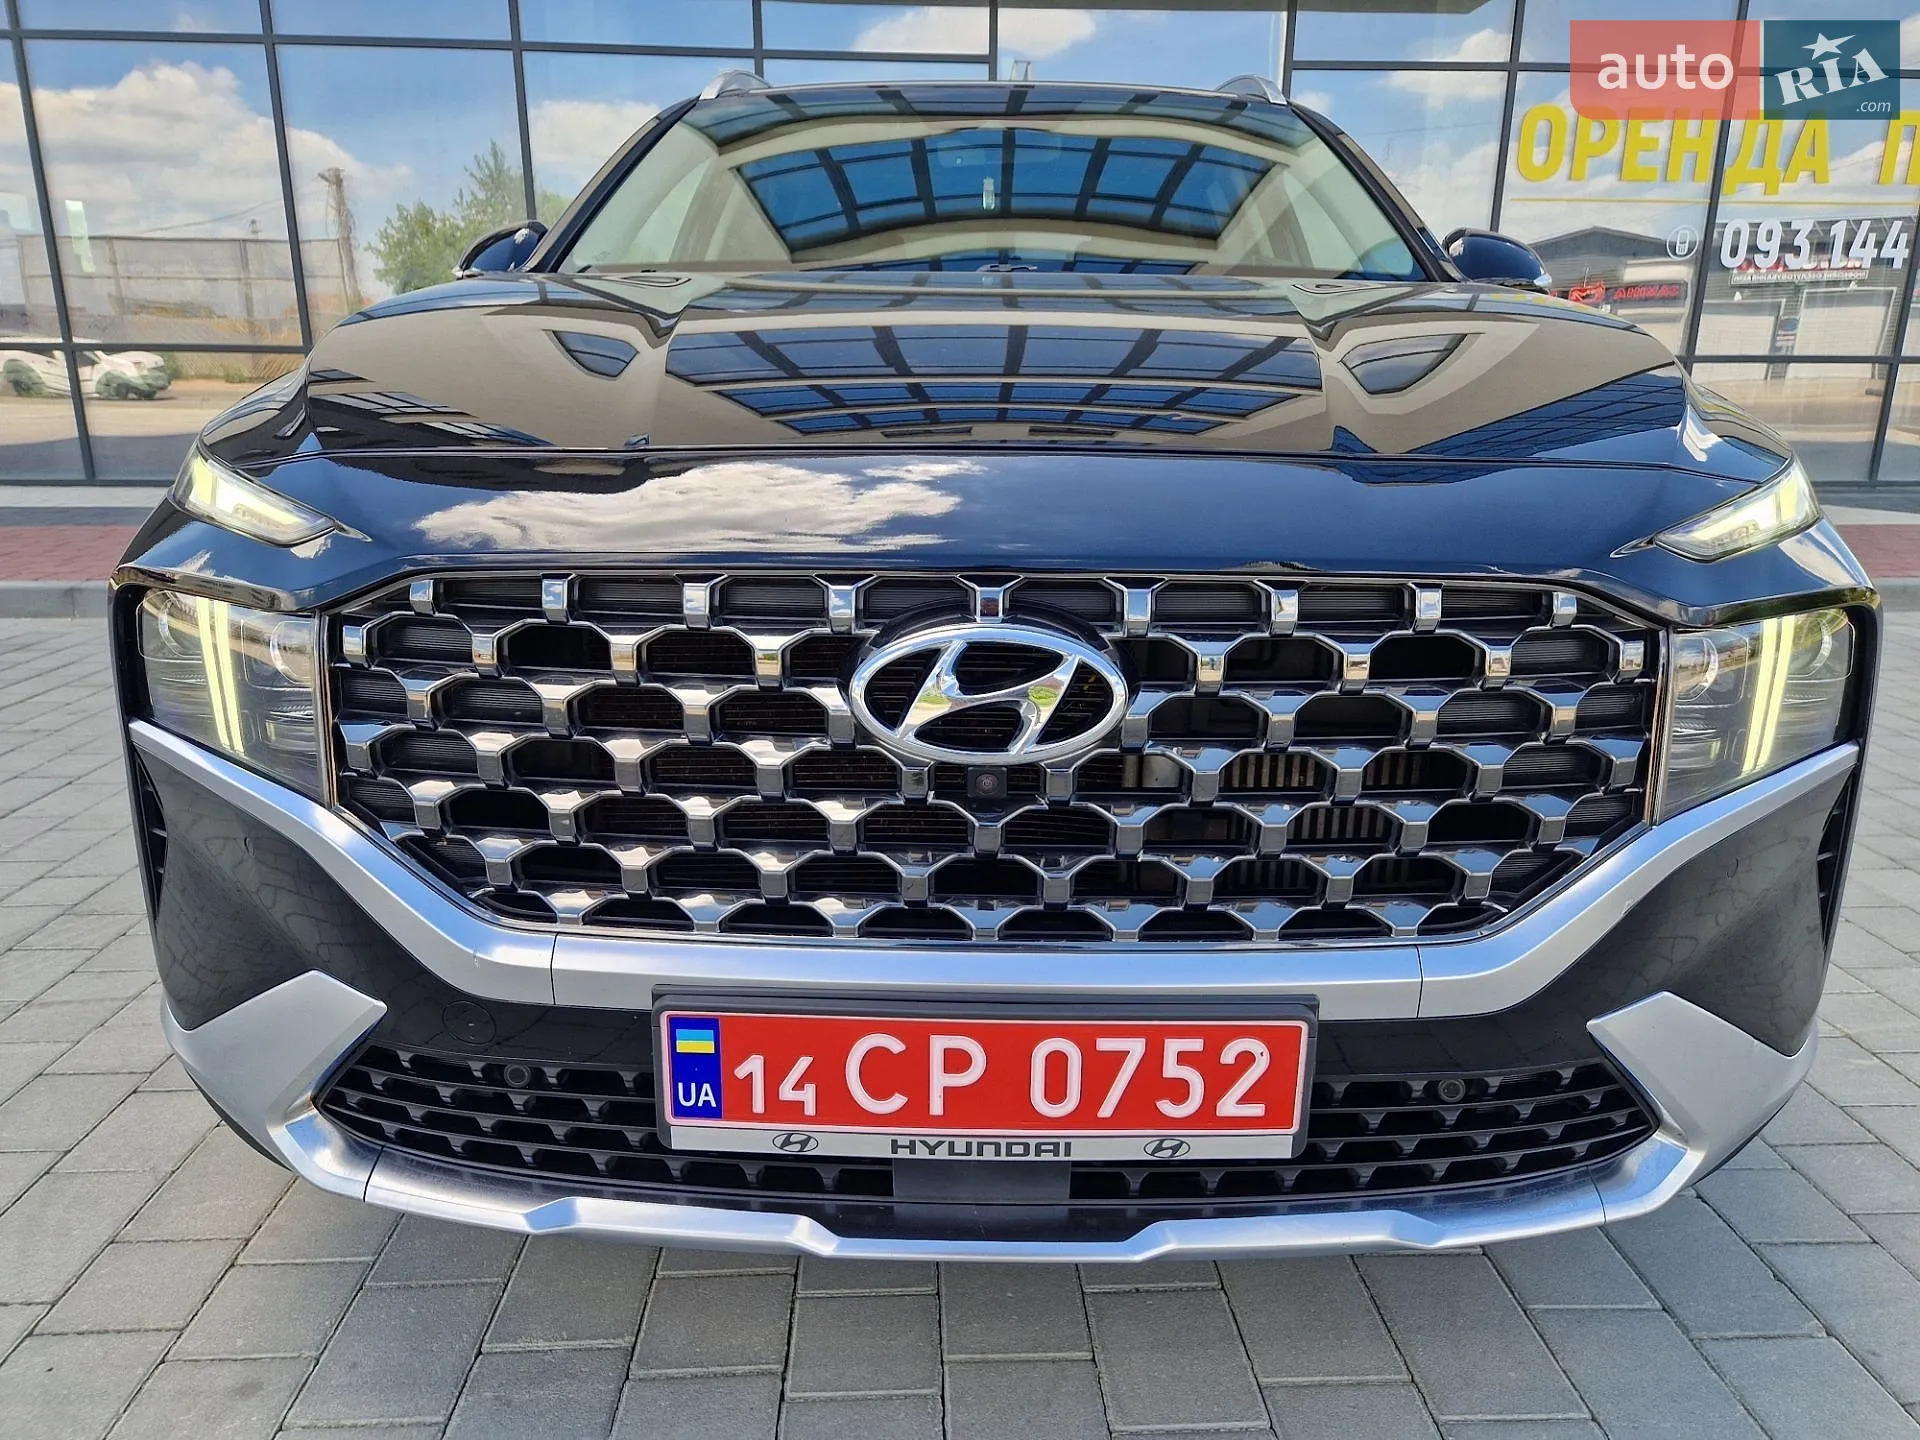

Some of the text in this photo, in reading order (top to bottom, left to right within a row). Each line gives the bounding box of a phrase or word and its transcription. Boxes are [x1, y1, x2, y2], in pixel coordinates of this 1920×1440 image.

[1517, 104, 1831, 195] ОРЕНДА
[677, 1081, 718, 1108] UA
[733, 1054, 817, 1117] 14
[1029, 1037, 1271, 1119] 0752
[890, 1138, 1073, 1159] HYUNDAI
